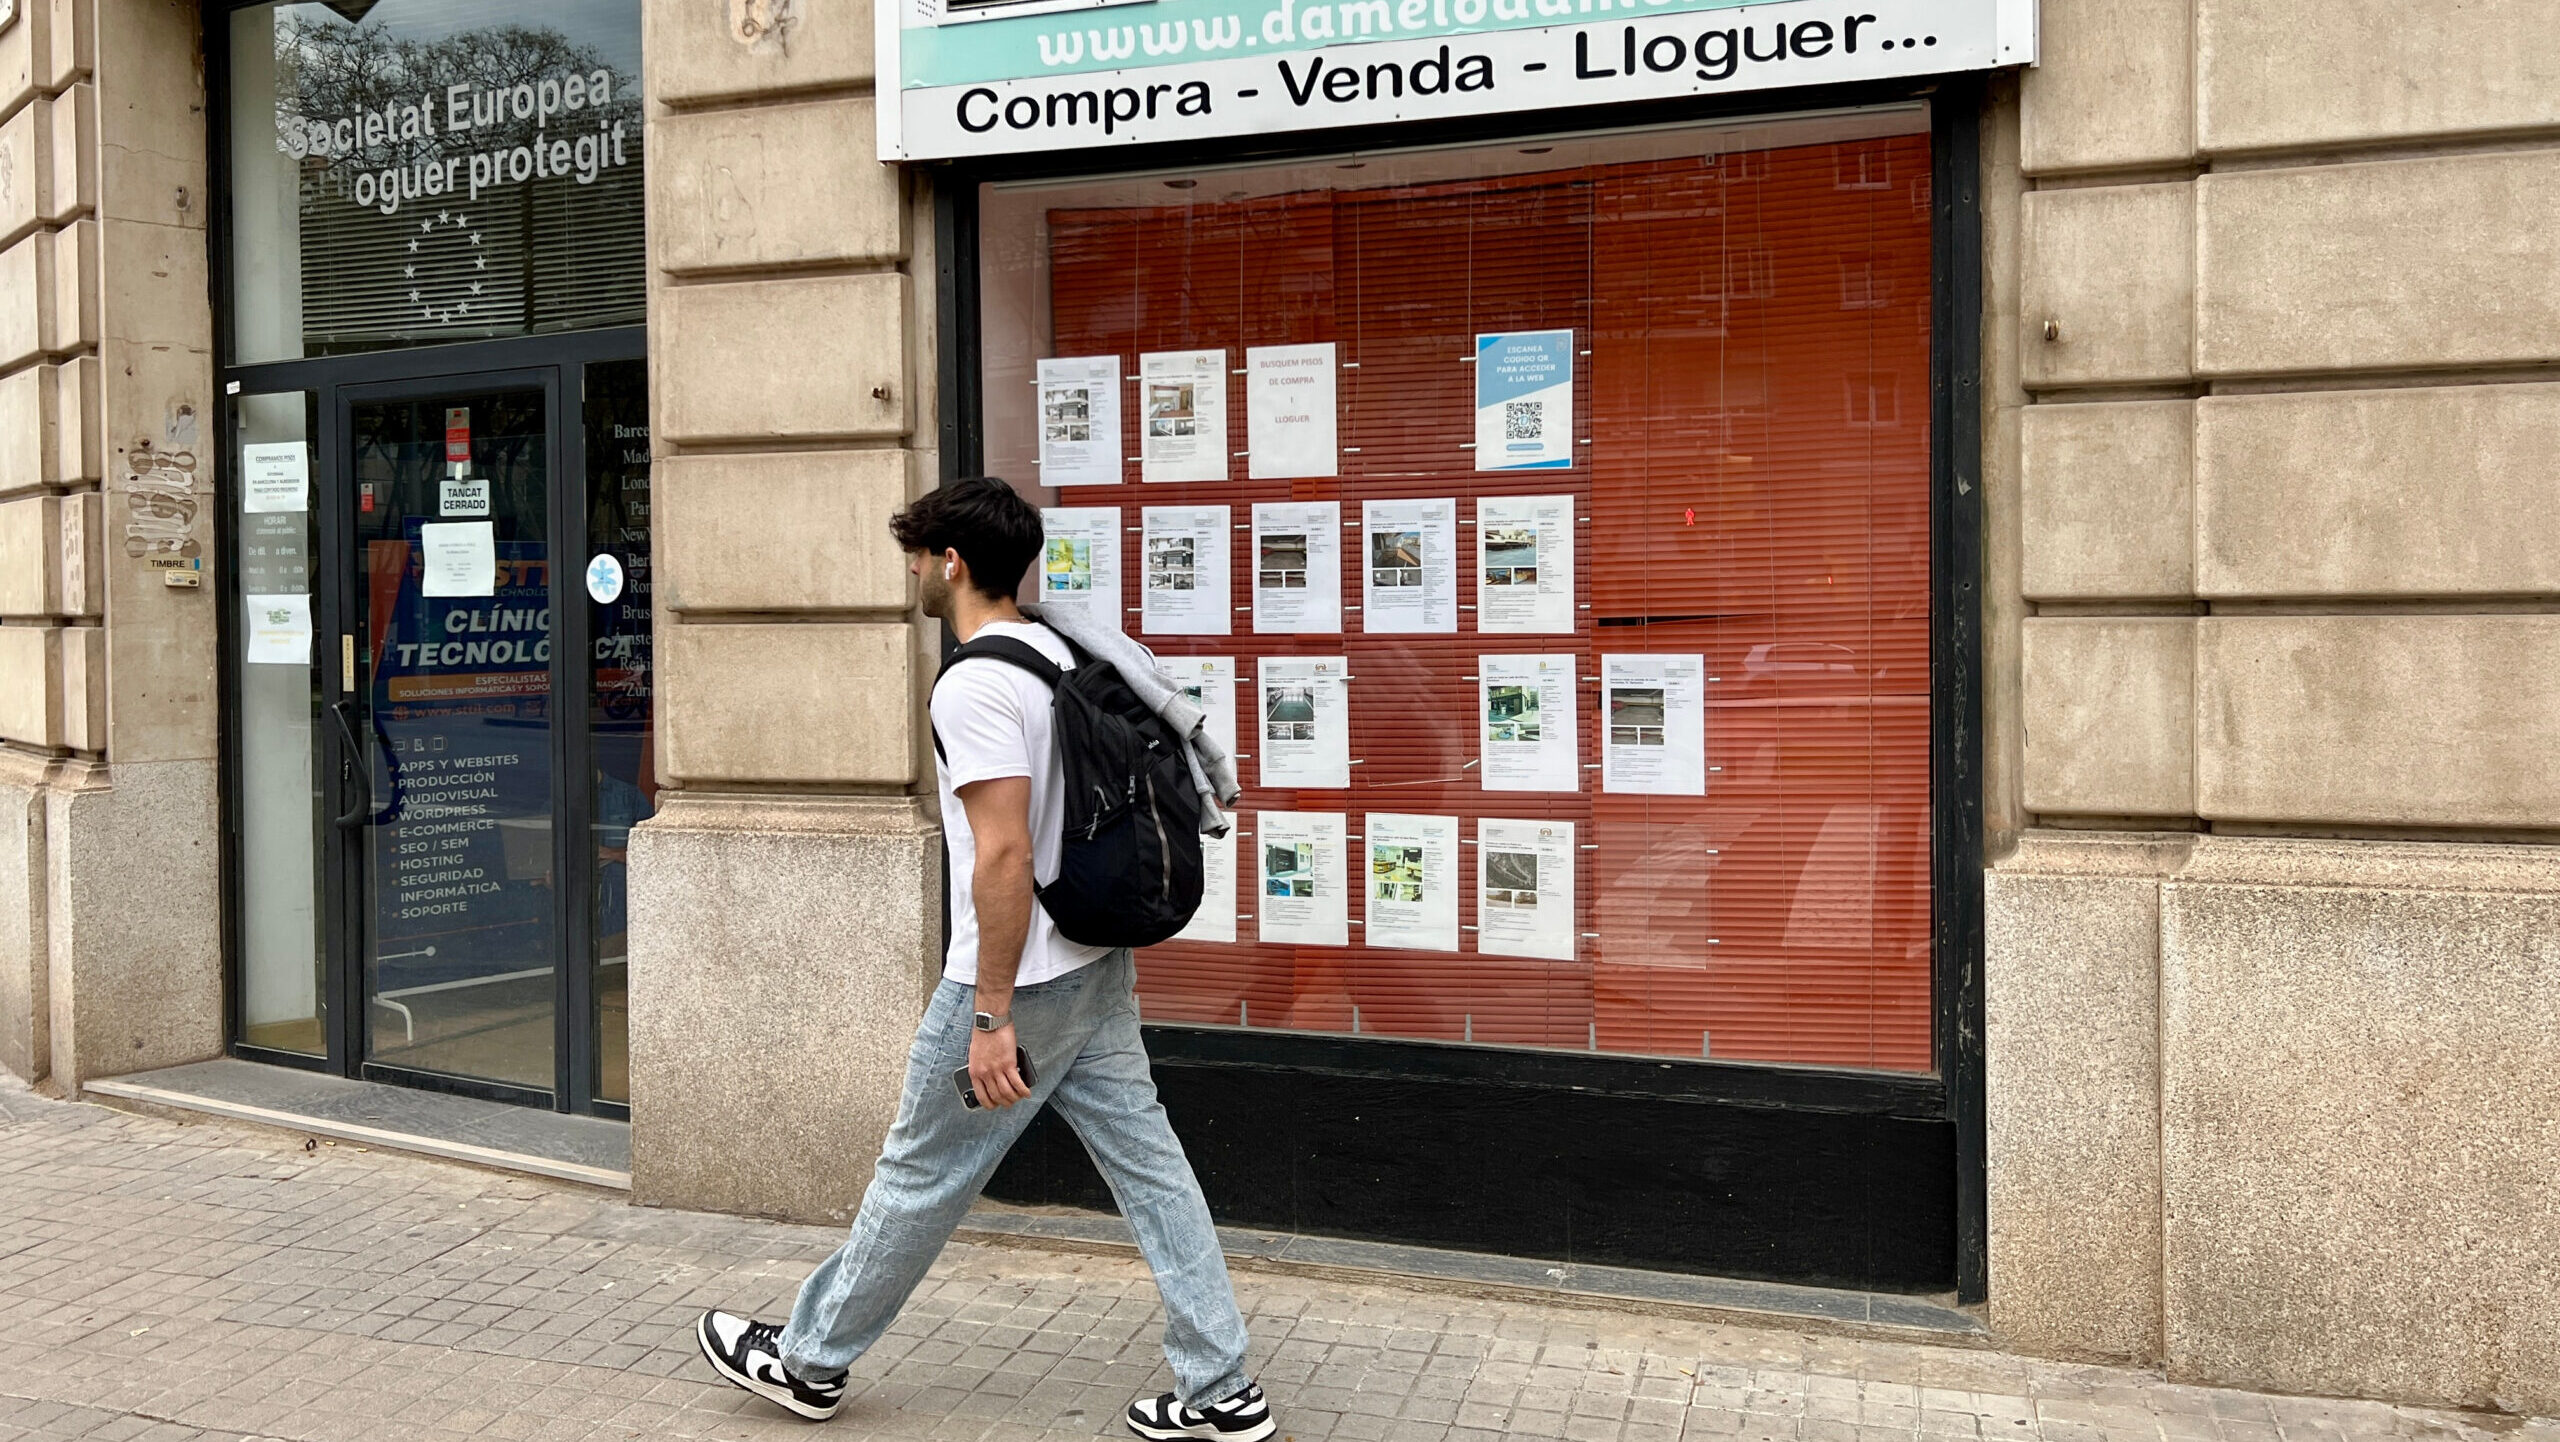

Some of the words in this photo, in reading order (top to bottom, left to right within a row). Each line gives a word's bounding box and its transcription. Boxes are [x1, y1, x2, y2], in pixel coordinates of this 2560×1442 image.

[1038, 0, 1696, 66] wwww.damelo
[956, 80, 1212, 135] Compra
[1237, 88, 1259, 98] -
[1278, 44, 1495, 106] Venda
[1523, 62, 1547, 72] -
[1575, 14, 1938, 81] Lloguer...
[286, 91, 435, 160] Societat
[447, 68, 612, 132] Europea
[355, 155, 460, 215] oguer
[469, 118, 627, 200] protegit
[1507, 345, 1543, 354] ESCANEA
[1260, 358, 1299, 369] BUSQUEM
[1301, 356, 1324, 367] PISOS
[1496, 366, 1517, 374] PARA
[1520, 364, 1556, 373] ACCEDER
[1268, 377, 1279, 386] DE
[1280, 376, 1315, 385] COMPRA
[1526, 374, 1545, 382] WEB
[1274, 415, 1310, 424] LLOGUER
[447, 488, 482, 498] TANCAT
[443, 499, 486, 510] CERRADO
[150, 560, 185, 568] TIMBRE
[475, 674, 546, 685] ESPECIALISTAS
[399, 689, 453, 698] SOLUCIONES
[398, 760, 435, 773] APPS
[439, 759, 448, 769] Y
[454, 754, 519, 769] WEBSITES
[398, 771, 495, 789] PRODUCCIÓN
[398, 788, 498, 806] AUDIOVISUAL
[399, 804, 487, 821] WORDPRESS
[400, 819, 495, 838] E-COMMERCE
[400, 842, 428, 855] SEO
[441, 837, 469, 850] SEM
[400, 854, 464, 871] HOSTING
[400, 868, 484, 887] SEGURIDAD
[401, 882, 501, 903] INFORMÁTICA
[402, 901, 468, 919] SOPORTE
